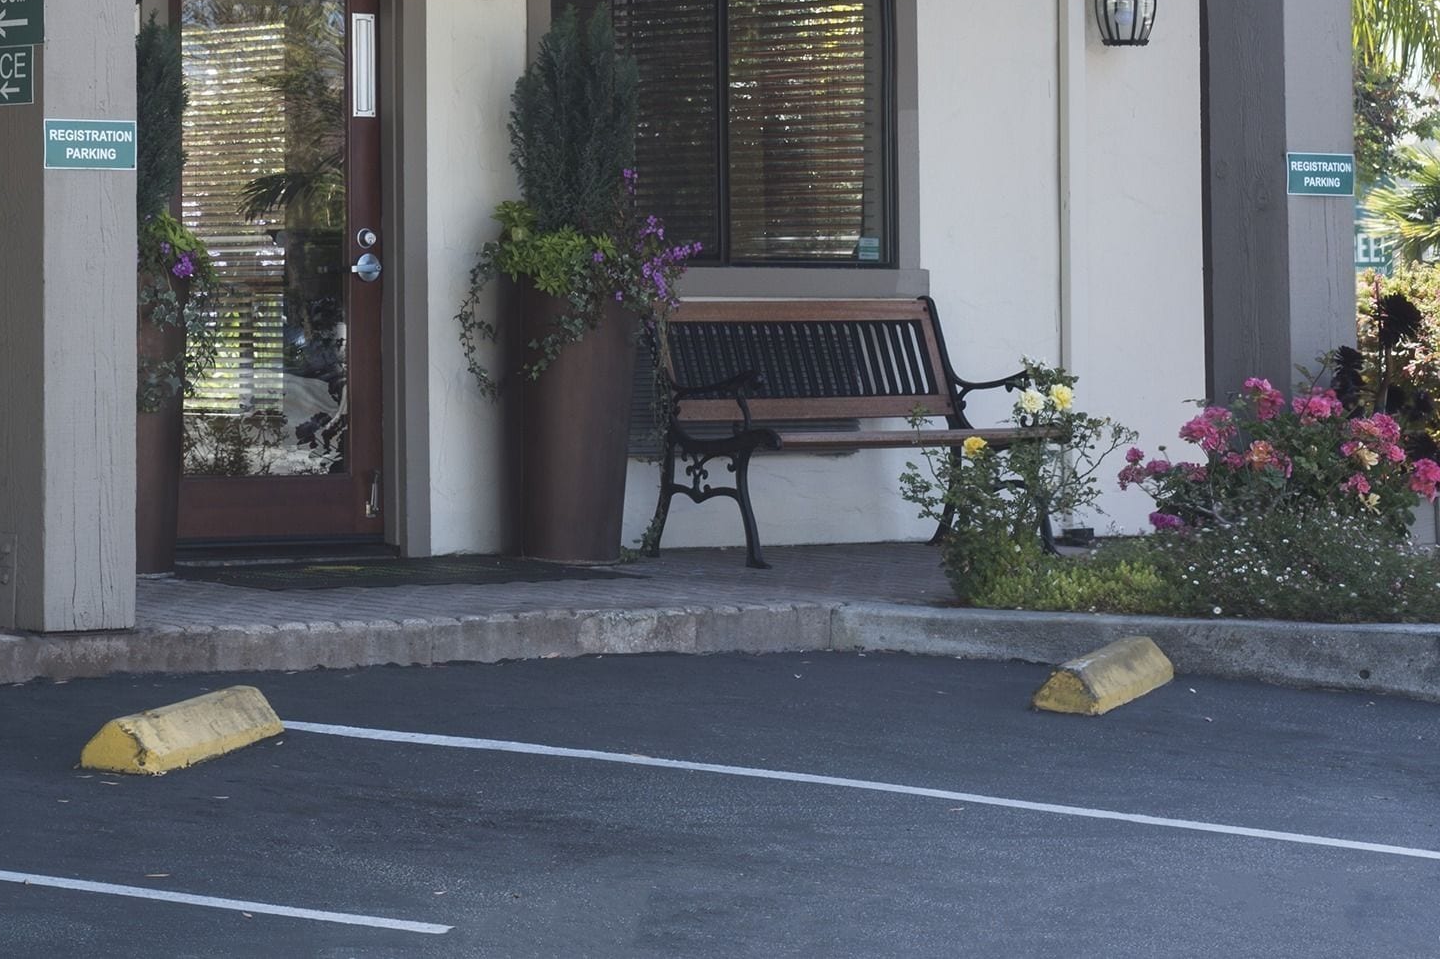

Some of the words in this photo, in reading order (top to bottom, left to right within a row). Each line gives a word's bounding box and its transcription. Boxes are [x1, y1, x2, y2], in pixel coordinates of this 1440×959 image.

[49, 129, 133, 142] REGISTRATION
[65, 147, 117, 160] PARKING
[1290, 161, 1352, 173] REGISTRATION
[1303, 176, 1341, 188] PARKING
[1354, 232, 1386, 263] EE!
